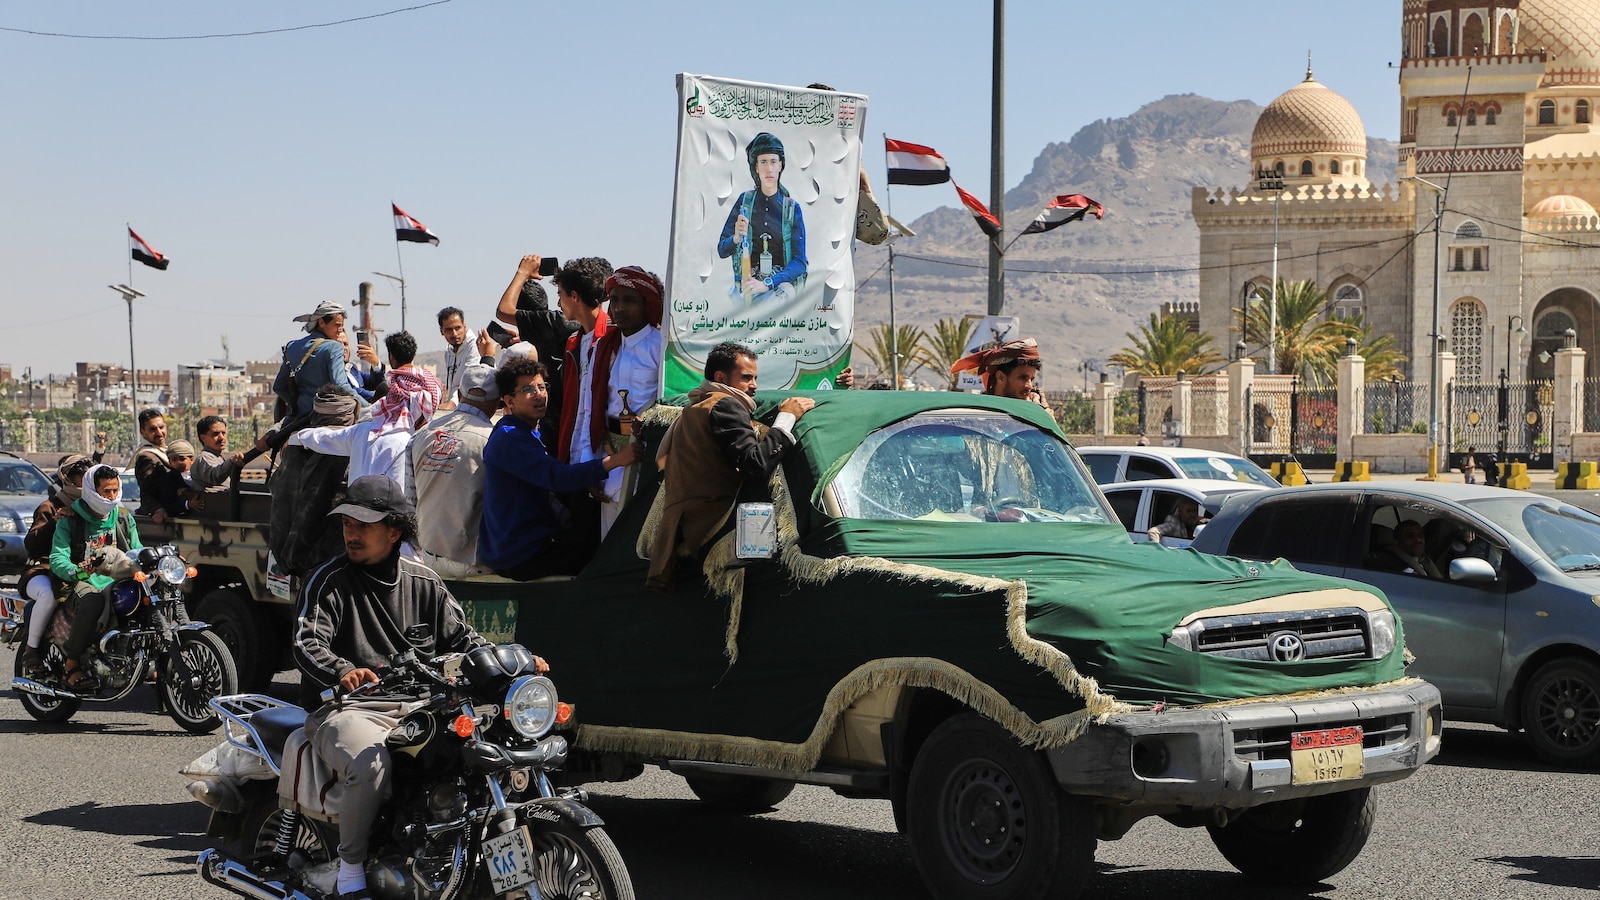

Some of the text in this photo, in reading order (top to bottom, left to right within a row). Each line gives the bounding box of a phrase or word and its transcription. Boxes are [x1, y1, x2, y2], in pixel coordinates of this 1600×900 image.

[692, 315, 728, 333] الرياشي
[779, 315, 806, 331] عبدالله
[808, 317, 828, 331] مازن
[1314, 766, 1343, 780] 15167
[526, 804, 561, 823] Cadillac
[493, 850, 517, 877] ٢٨٢
[500, 874, 519, 890] 282
